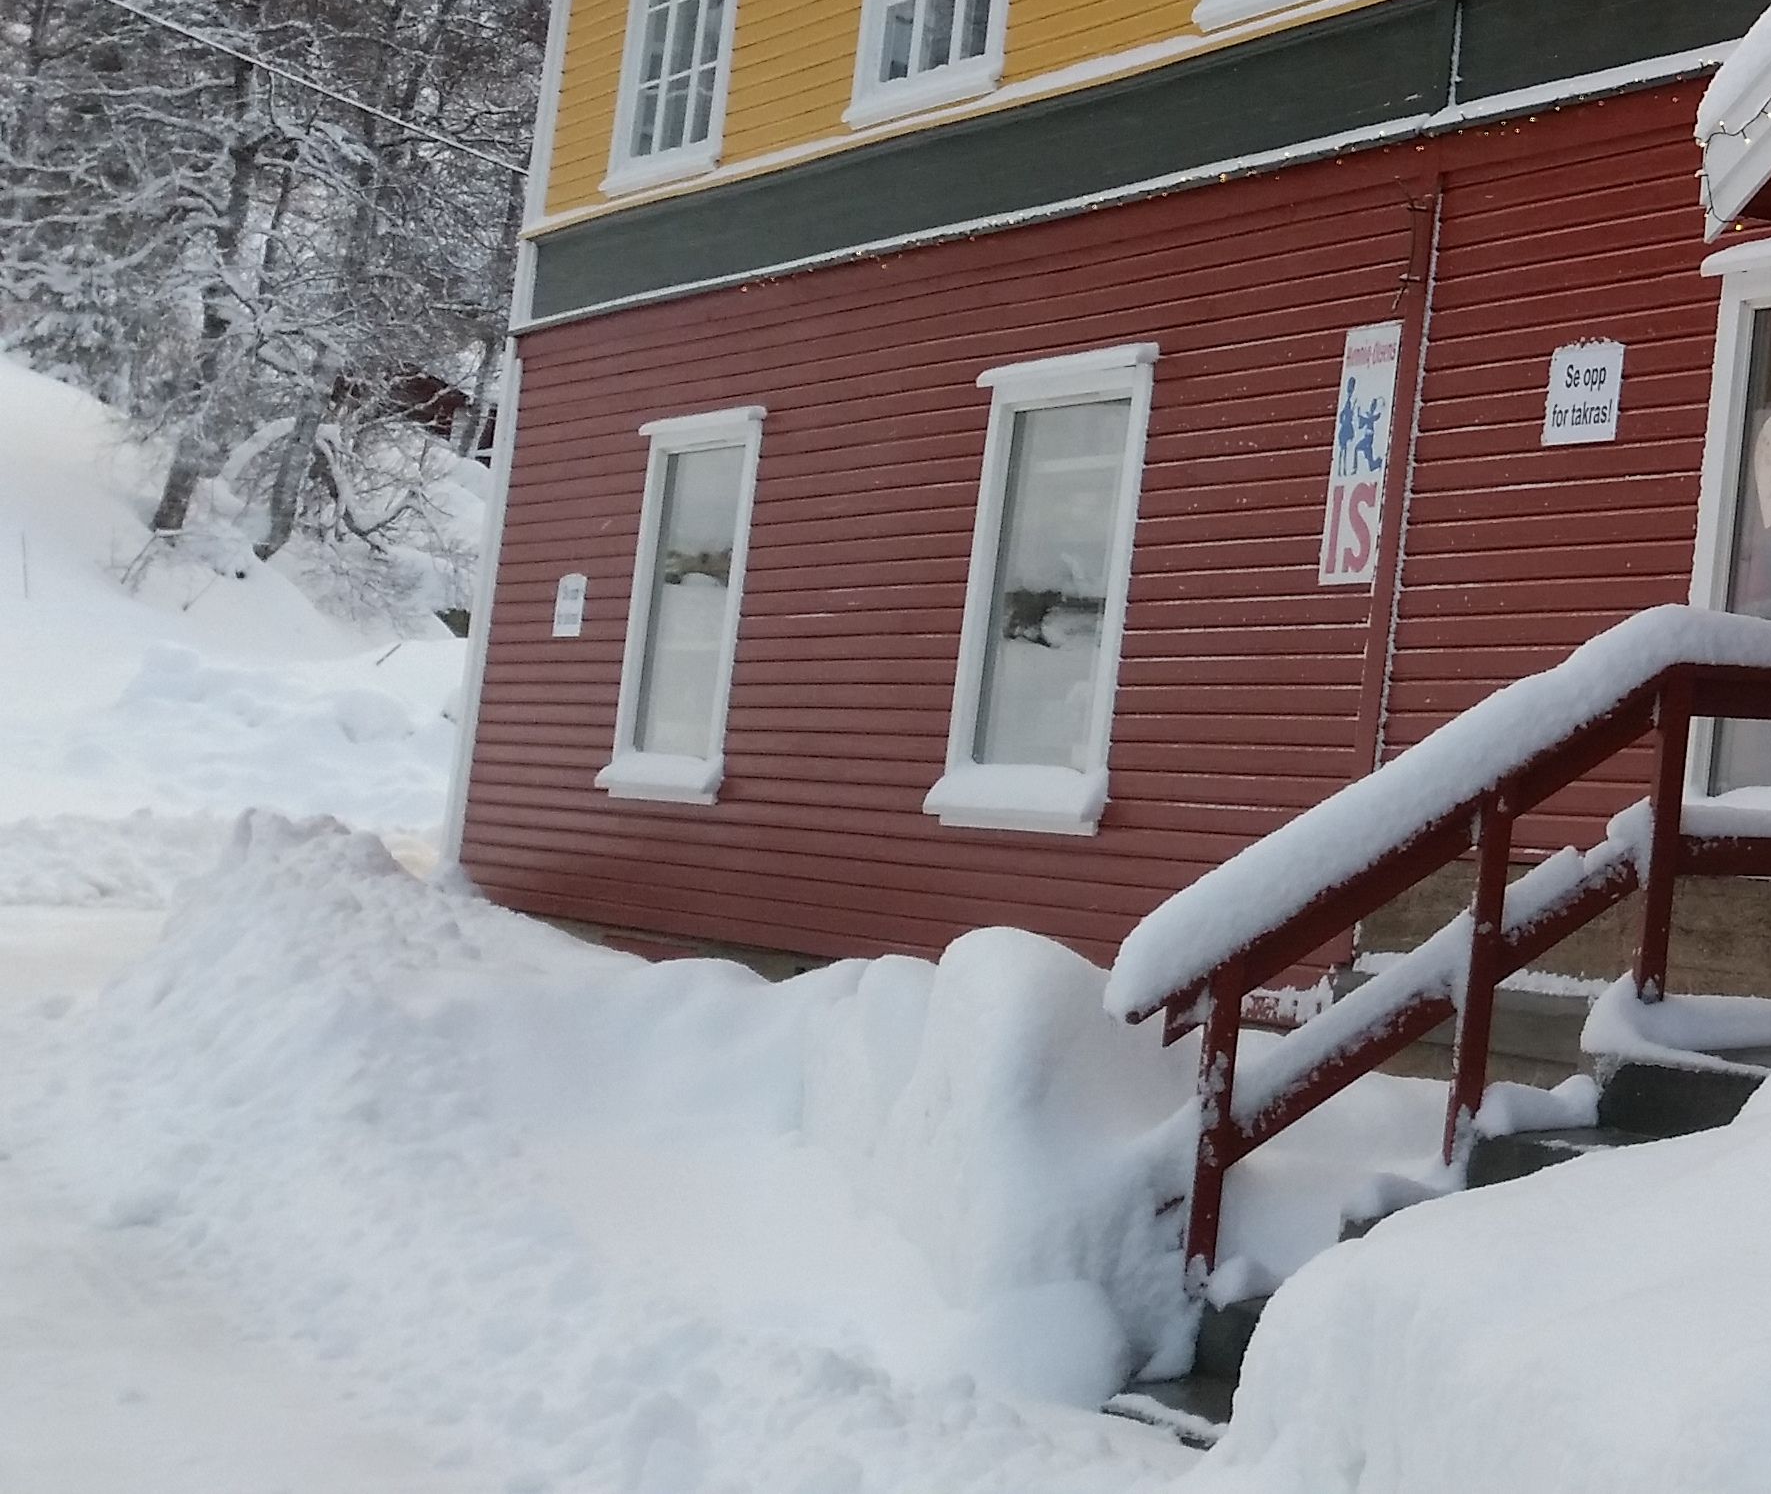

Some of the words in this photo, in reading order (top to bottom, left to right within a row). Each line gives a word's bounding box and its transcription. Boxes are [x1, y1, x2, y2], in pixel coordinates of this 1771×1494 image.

[1565, 364, 1580, 388] Se
[1583, 366, 1607, 392] opp
[1551, 403, 1569, 428] for
[1571, 398, 1613, 426] takras!
[1325, 481, 1378, 574] IS
